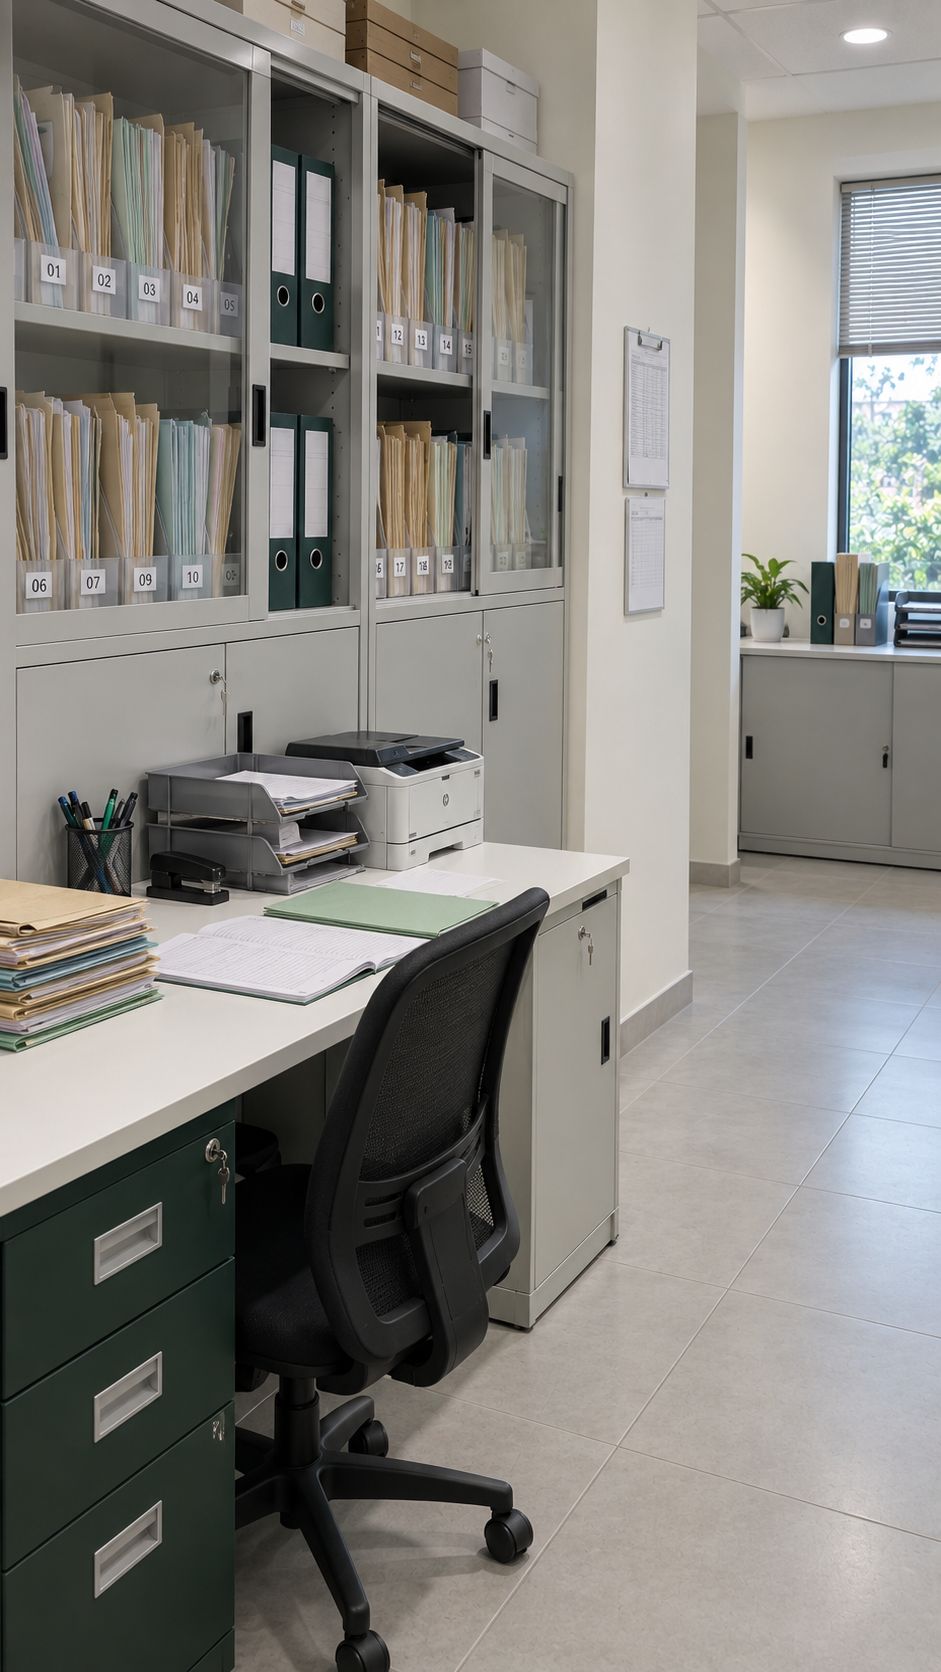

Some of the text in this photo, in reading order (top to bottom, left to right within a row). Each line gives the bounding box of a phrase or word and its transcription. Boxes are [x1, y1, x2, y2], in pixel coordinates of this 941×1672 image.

[47, 262, 61, 279] 01
[97, 273, 111, 288] 02
[143, 282, 156, 296] 03
[186, 290, 199, 304] 04
[224, 298, 235, 312] 05
[394, 330, 402, 341] 12
[417, 334, 425, 346] 13
[443, 339, 451, 350] 14
[396, 561, 404, 573] 17
[86, 576, 100, 590] 07
[139, 573, 152, 587] 09
[187, 571, 199, 584] 10
[31, 578, 47, 593] 06
